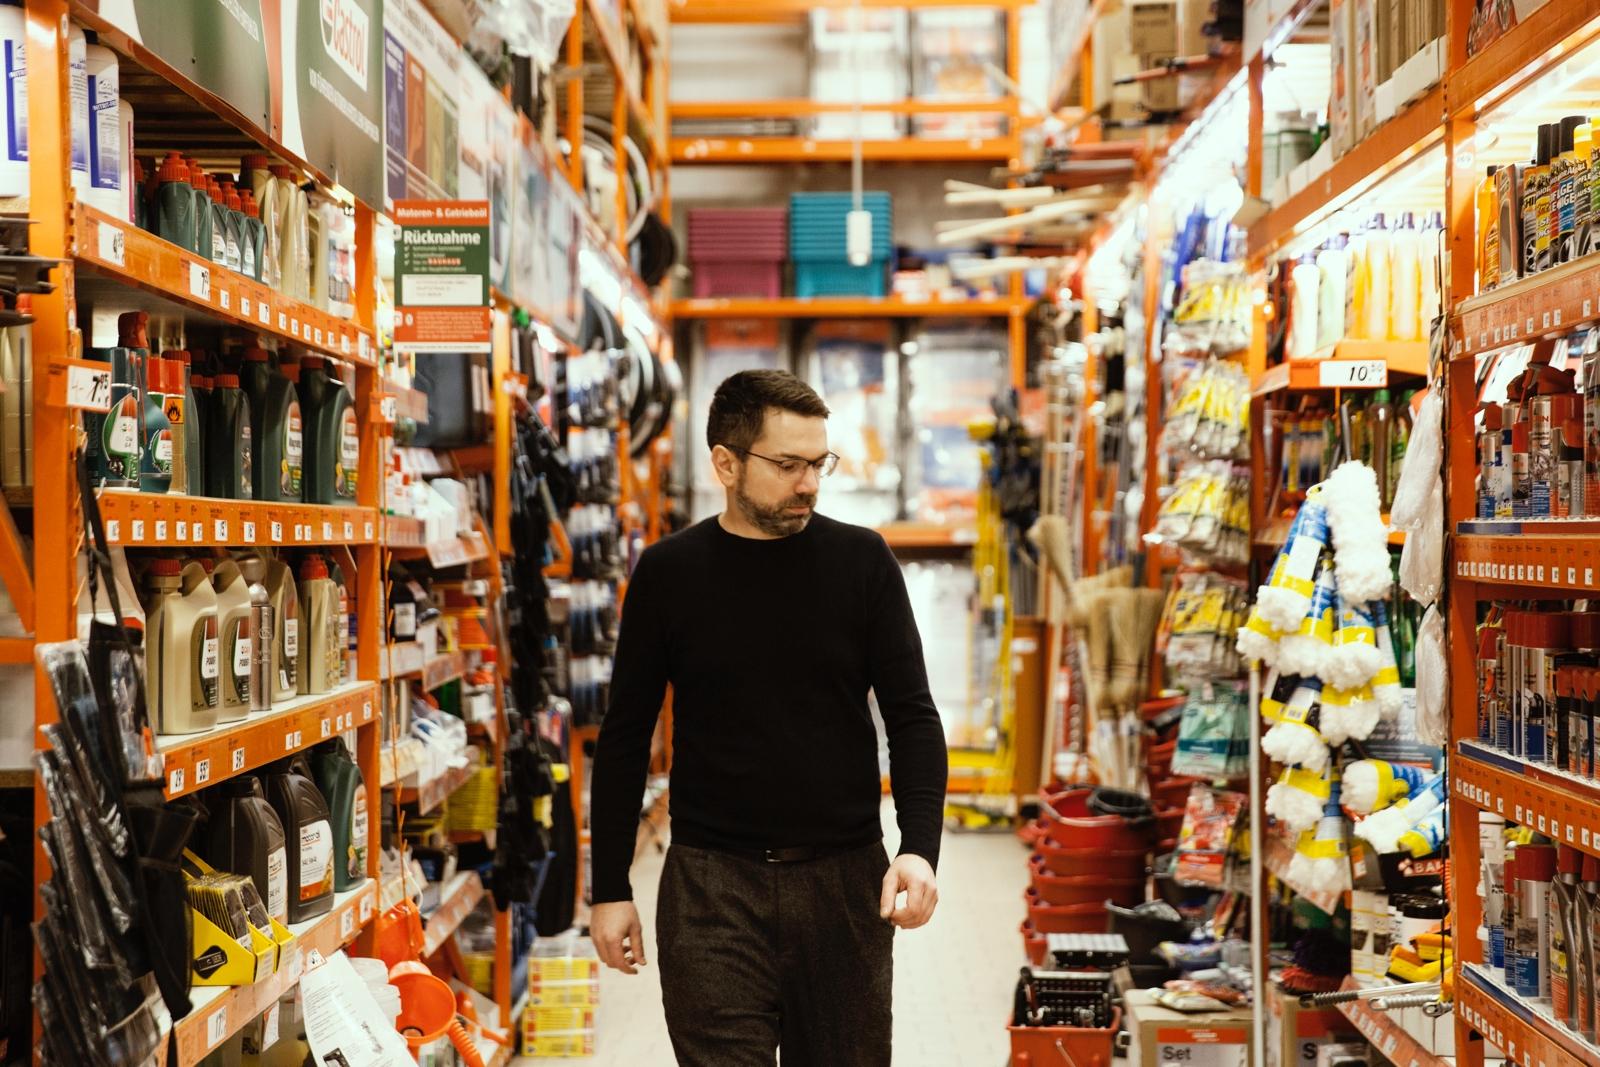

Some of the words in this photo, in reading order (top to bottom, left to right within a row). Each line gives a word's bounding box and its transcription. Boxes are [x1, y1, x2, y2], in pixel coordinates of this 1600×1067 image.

[396, 207, 434, 218] Motoren-
[436, 207, 443, 218] &
[445, 206, 488, 218] Getriebeöl
[403, 230, 481, 245] Rücknahme
[1162, 1046, 1192, 1060] Set
